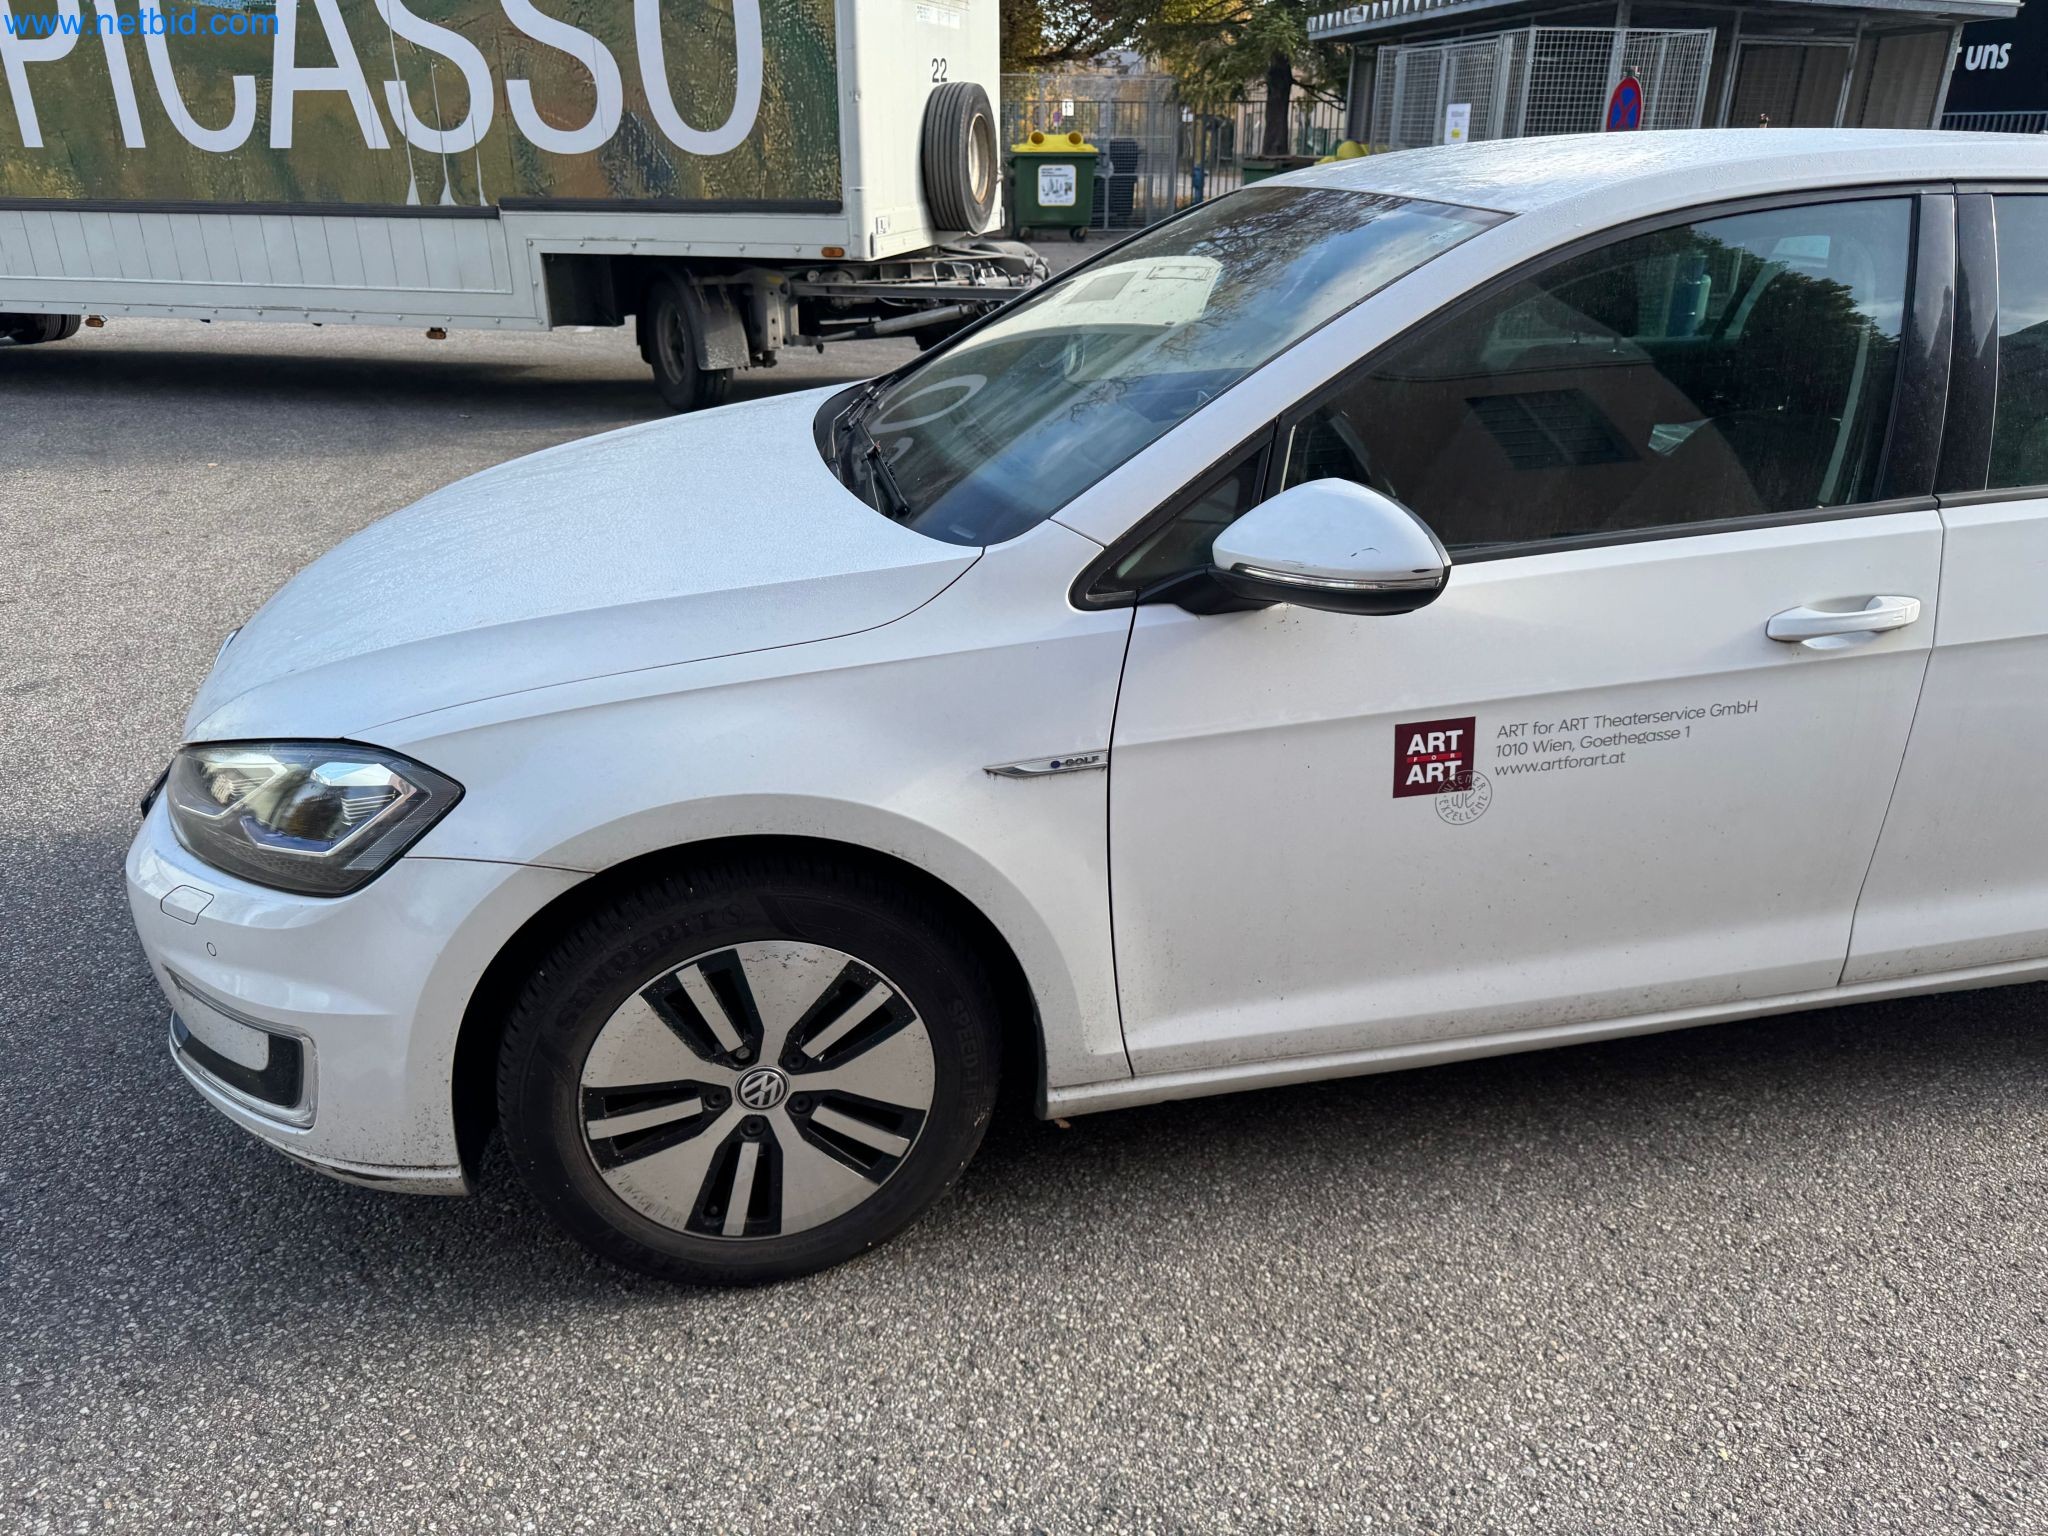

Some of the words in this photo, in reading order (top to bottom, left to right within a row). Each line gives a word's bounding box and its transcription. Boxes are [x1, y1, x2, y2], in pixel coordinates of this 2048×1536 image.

[1965, 42, 2012, 71] uns
[0, 0, 763, 155] PICASSO
[931, 57, 948, 83] 22
[1497, 723, 1528, 739] ART
[1533, 721, 1554, 735] for
[1558, 716, 1589, 732] ART
[1594, 705, 1706, 729] Theaterservice
[1710, 699, 1759, 717] GmbH
[1406, 729, 1463, 756] ART
[1496, 742, 1528, 757] 1010
[1533, 739, 1576, 754] Wien,
[1580, 728, 1681, 749] Goethegasse
[1684, 725, 1691, 738] 1
[1413, 752, 1456, 763] FOR
[1495, 751, 1626, 776] www.artforart.at
[1405, 760, 1463, 786] ART
[1443, 774, 1486, 793] WIENER
[1439, 795, 1488, 821] EXZELLENZ
